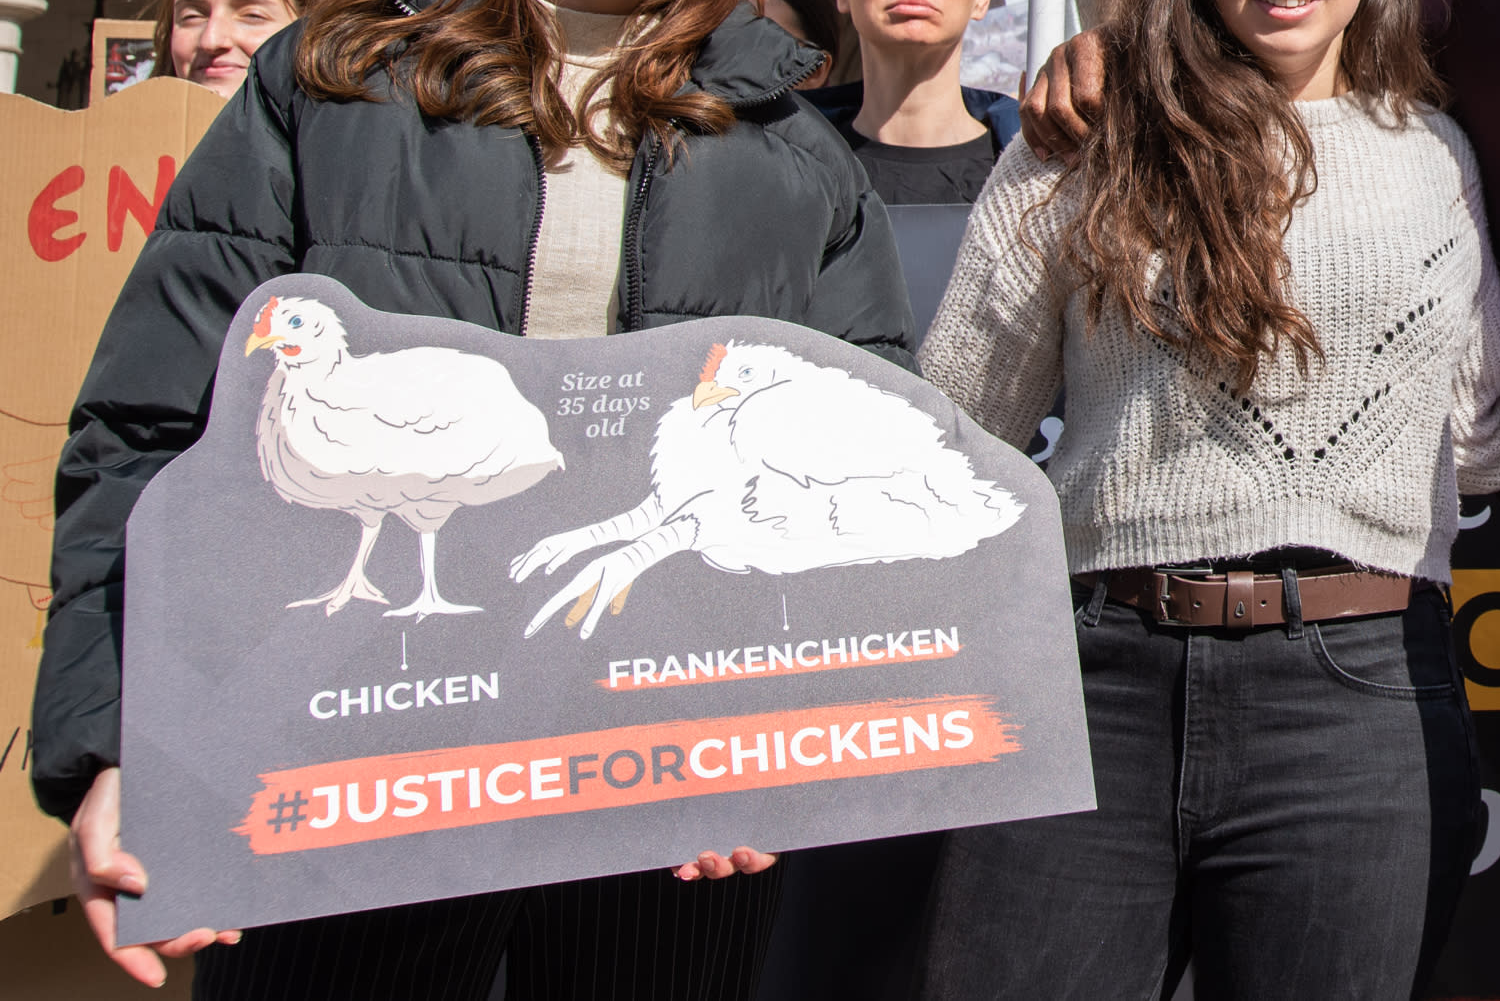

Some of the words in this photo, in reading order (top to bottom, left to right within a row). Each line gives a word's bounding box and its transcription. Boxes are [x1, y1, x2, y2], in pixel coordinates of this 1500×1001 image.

[561, 372, 612, 392] Size
[618, 370, 645, 388] at
[557, 397, 585, 416] 35
[592, 394, 651, 417] days
[585, 417, 625, 439] old
[607, 625, 961, 688] FRANKENCHICKEN
[308, 670, 500, 720] CHICKEN
[267, 709, 975, 833] #JUSTICEFORCHICKENS
